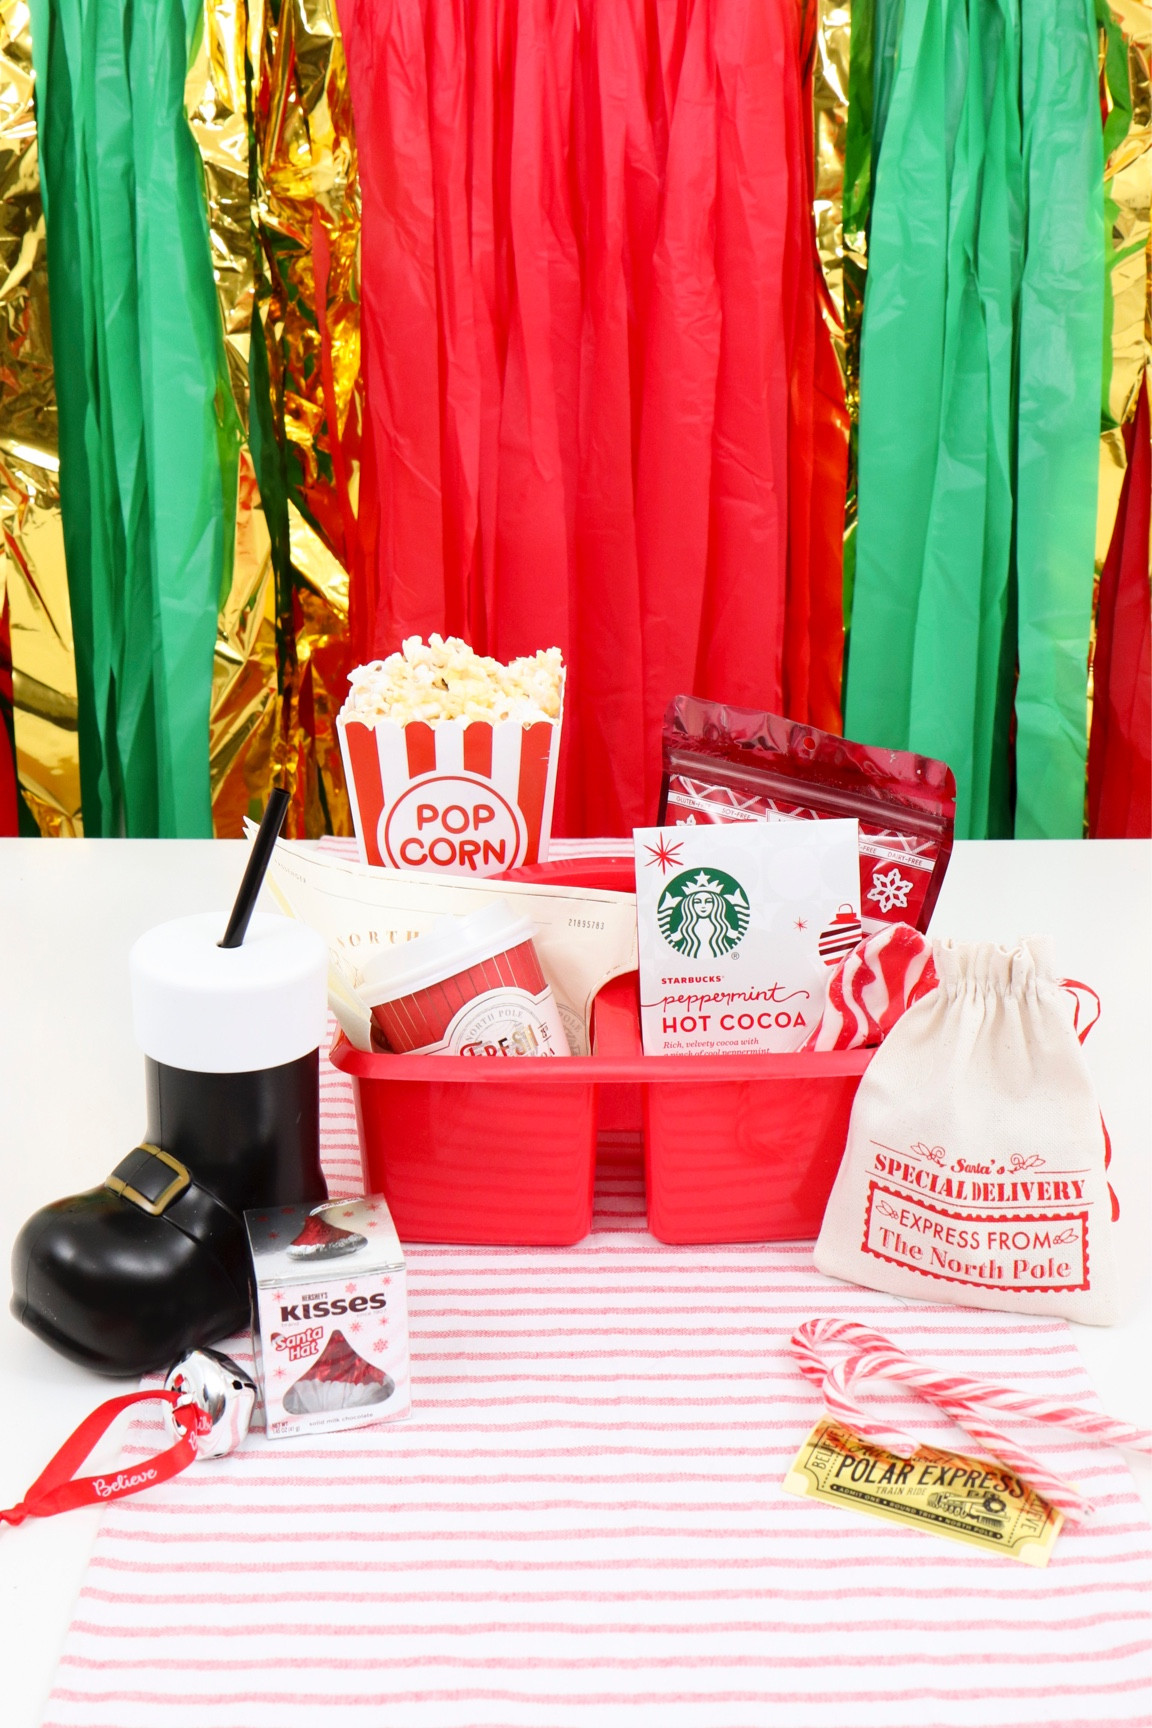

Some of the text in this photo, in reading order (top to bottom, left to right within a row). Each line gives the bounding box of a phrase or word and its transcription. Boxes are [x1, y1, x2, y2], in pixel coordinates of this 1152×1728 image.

[417, 803, 495, 834] POP
[400, 837, 506, 871] CORN
[661, 975, 722, 985] STARBUCKS
[643, 982, 810, 1012] peppermint
[662, 1011, 807, 1033] HOT COCOA
[663, 1041, 684, 1049] Rich,
[686, 1039, 715, 1049] velvety
[741, 1037, 759, 1045] with
[874, 1153, 1085, 1202] SPECIAL DELIVERY
[951, 1158, 1005, 1175] Santa's
[900, 1209, 1051, 1250] EXPRESS FROM
[879, 1226, 1072, 1279] The North Pole
[276, 1326, 323, 1351] Santa
[289, 1341, 319, 1361] Hat
[92, 1468, 158, 1497] Believe
[835, 1454, 1024, 1499] POLAR EXPRESS
[875, 1486, 928, 1496] TRAIN RIDE
[838, 1487, 864, 1499] ADMIT
[864, 1495, 880, 1503] ONE
[918, 1510, 937, 1520] TRIP
[945, 1518, 972, 1530] NORTH
[973, 1527, 994, 1537] POLE
